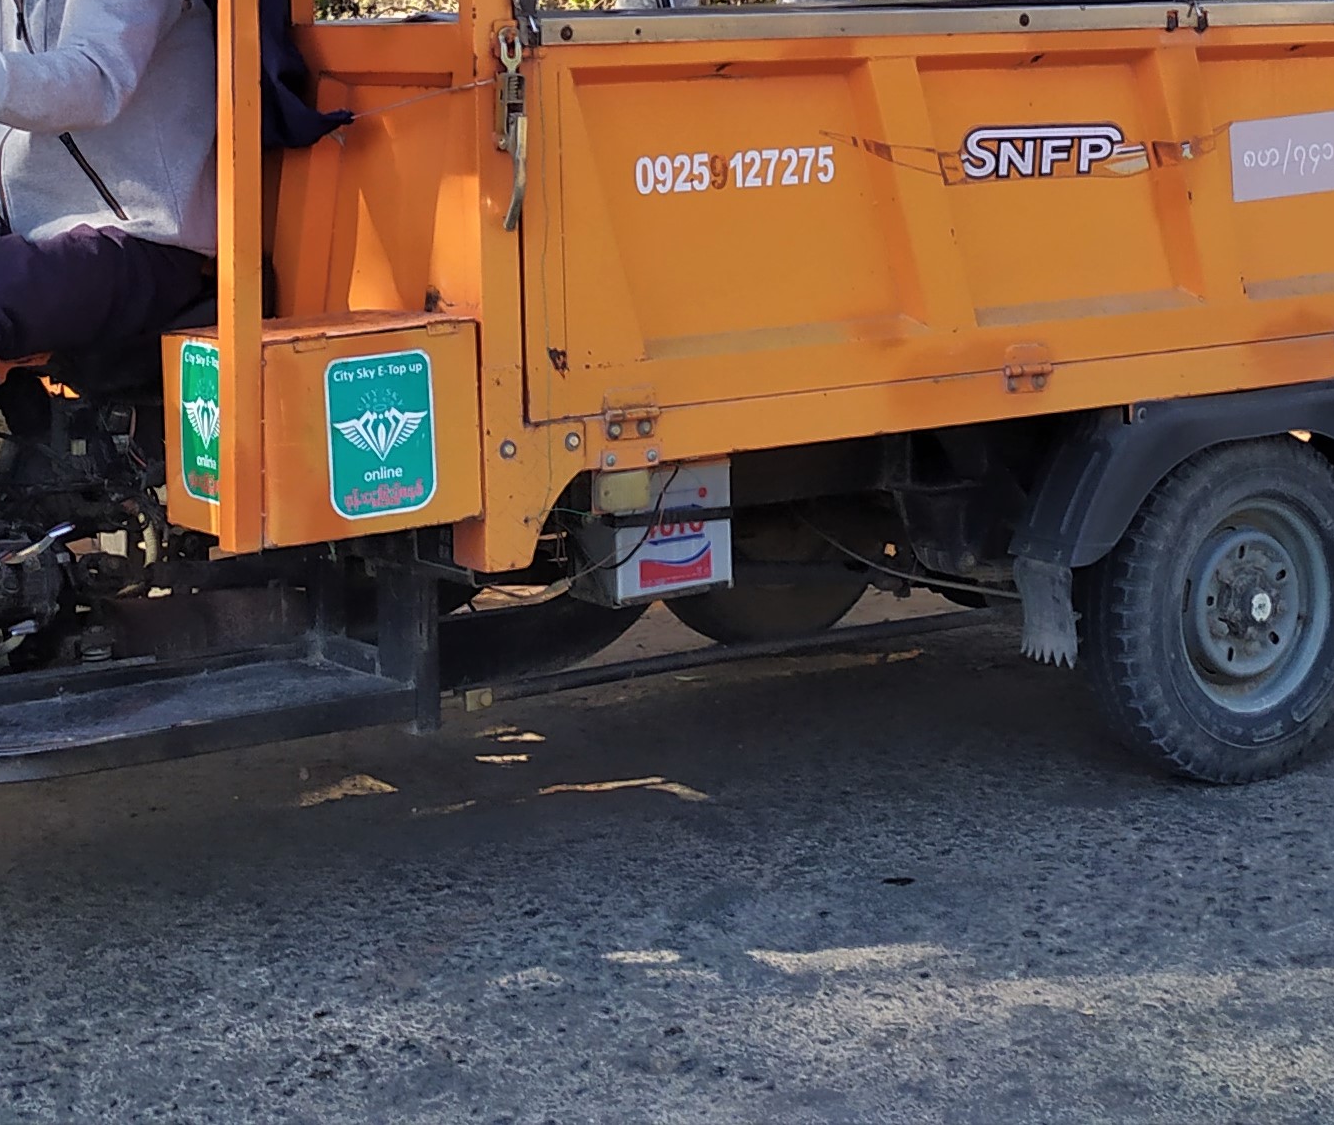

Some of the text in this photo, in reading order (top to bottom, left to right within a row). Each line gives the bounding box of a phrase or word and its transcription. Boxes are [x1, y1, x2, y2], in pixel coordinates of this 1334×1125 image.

[961, 125, 1123, 178] SNFP
[635, 146, 835, 195] 09259127275
[333, 370, 354, 382] City
[356, 367, 375, 379] Sky
[408, 363, 423, 373] up
[364, 466, 403, 482] online
